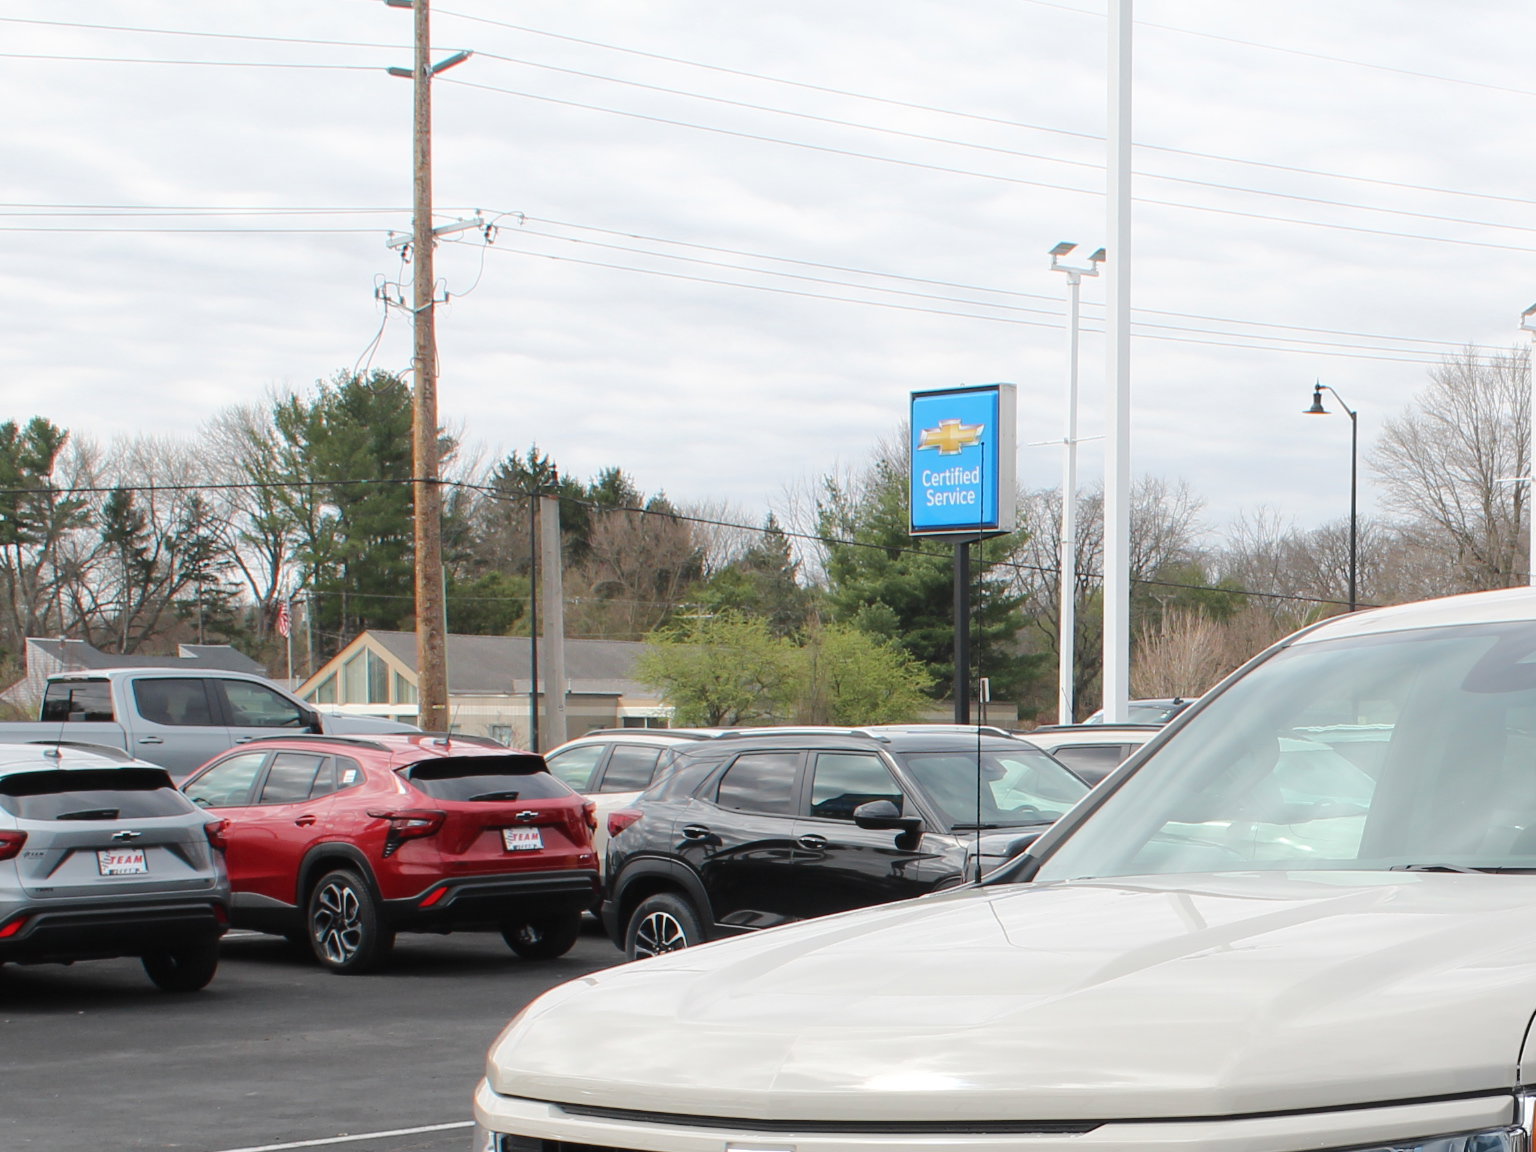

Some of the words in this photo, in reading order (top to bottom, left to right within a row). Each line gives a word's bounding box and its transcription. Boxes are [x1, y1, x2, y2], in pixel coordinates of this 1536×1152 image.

[922, 466, 980, 487] Certified
[926, 487, 976, 507] Service
[511, 833, 539, 842] TEAM
[110, 855, 143, 864] TEAM
